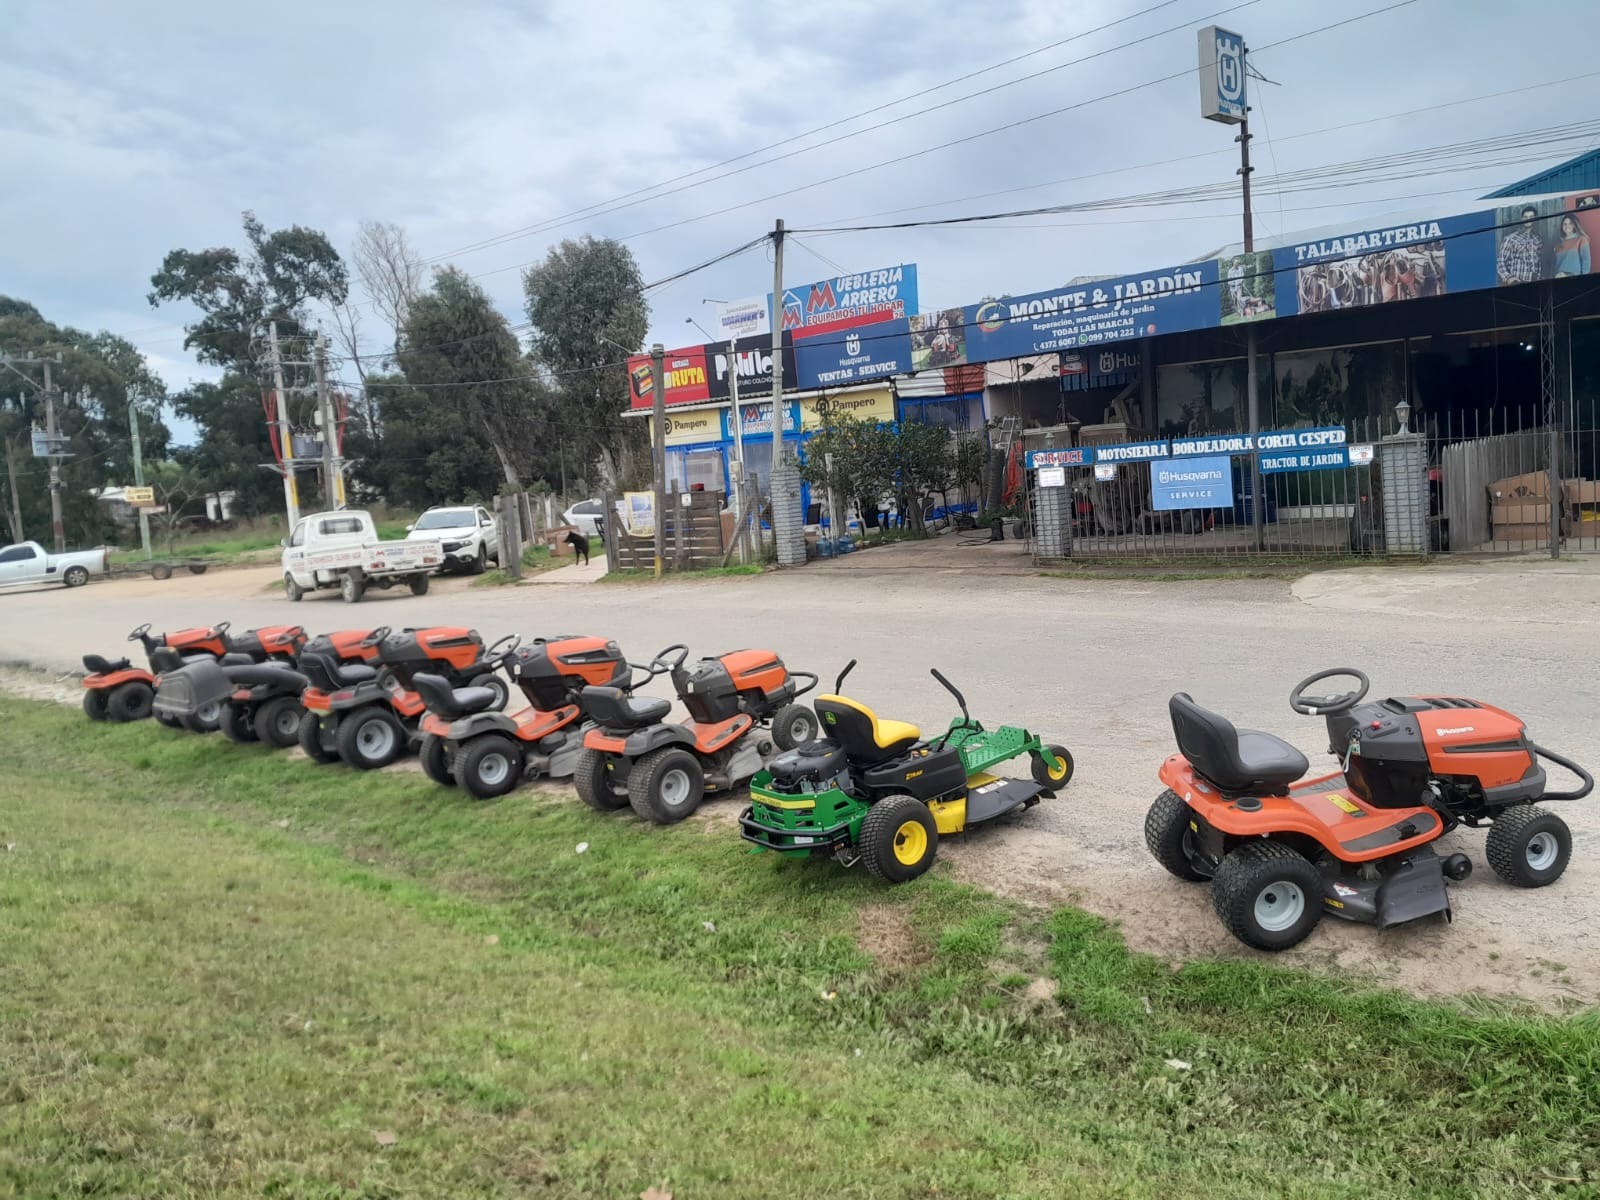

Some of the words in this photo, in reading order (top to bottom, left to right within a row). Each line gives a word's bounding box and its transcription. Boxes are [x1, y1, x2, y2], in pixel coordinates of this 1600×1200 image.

[1295, 222, 1443, 260] TALABARTERIA
[1009, 291, 1087, 323] MONTE
[1092, 288, 1109, 308] &
[1113, 268, 1202, 311] JARDÍN
[806, 307, 855, 326] EQUIPAMOS
[857, 304, 870, 317] TU
[869, 299, 904, 314] HOGAR
[1076, 311, 1119, 324] maquinaria
[1120, 307, 1130, 315] de
[1052, 326, 1079, 337] TODAS
[1080, 323, 1097, 333] LAS
[1097, 318, 1135, 330] MARCAS
[1040, 341, 1057, 350] 4372
[1088, 333, 1103, 342] 099
[1104, 331, 1119, 340] 704
[1120, 328, 1135, 337] 222
[839, 355, 871, 367] Husqvarna
[818, 368, 853, 383] VENTAS
[859, 361, 897, 376] SERVICE
[832, 398, 876, 411] Pampero
[674, 419, 708, 431] Pampero
[1172, 437, 1254, 455] BORDEADORA
[1258, 433, 1297, 449] CORTA
[1299, 430, 1346, 446] CESPED
[1032, 450, 1083, 465] SERVICE
[1097, 443, 1168, 461] MOTOSIERRA
[1262, 457, 1298, 470] TRACTOR
[1300, 456, 1310, 467] DE
[1312, 452, 1344, 467] JARDÍN
[1169, 470, 1222, 482] Husqvarna
[1170, 490, 1213, 499] SERVICE
